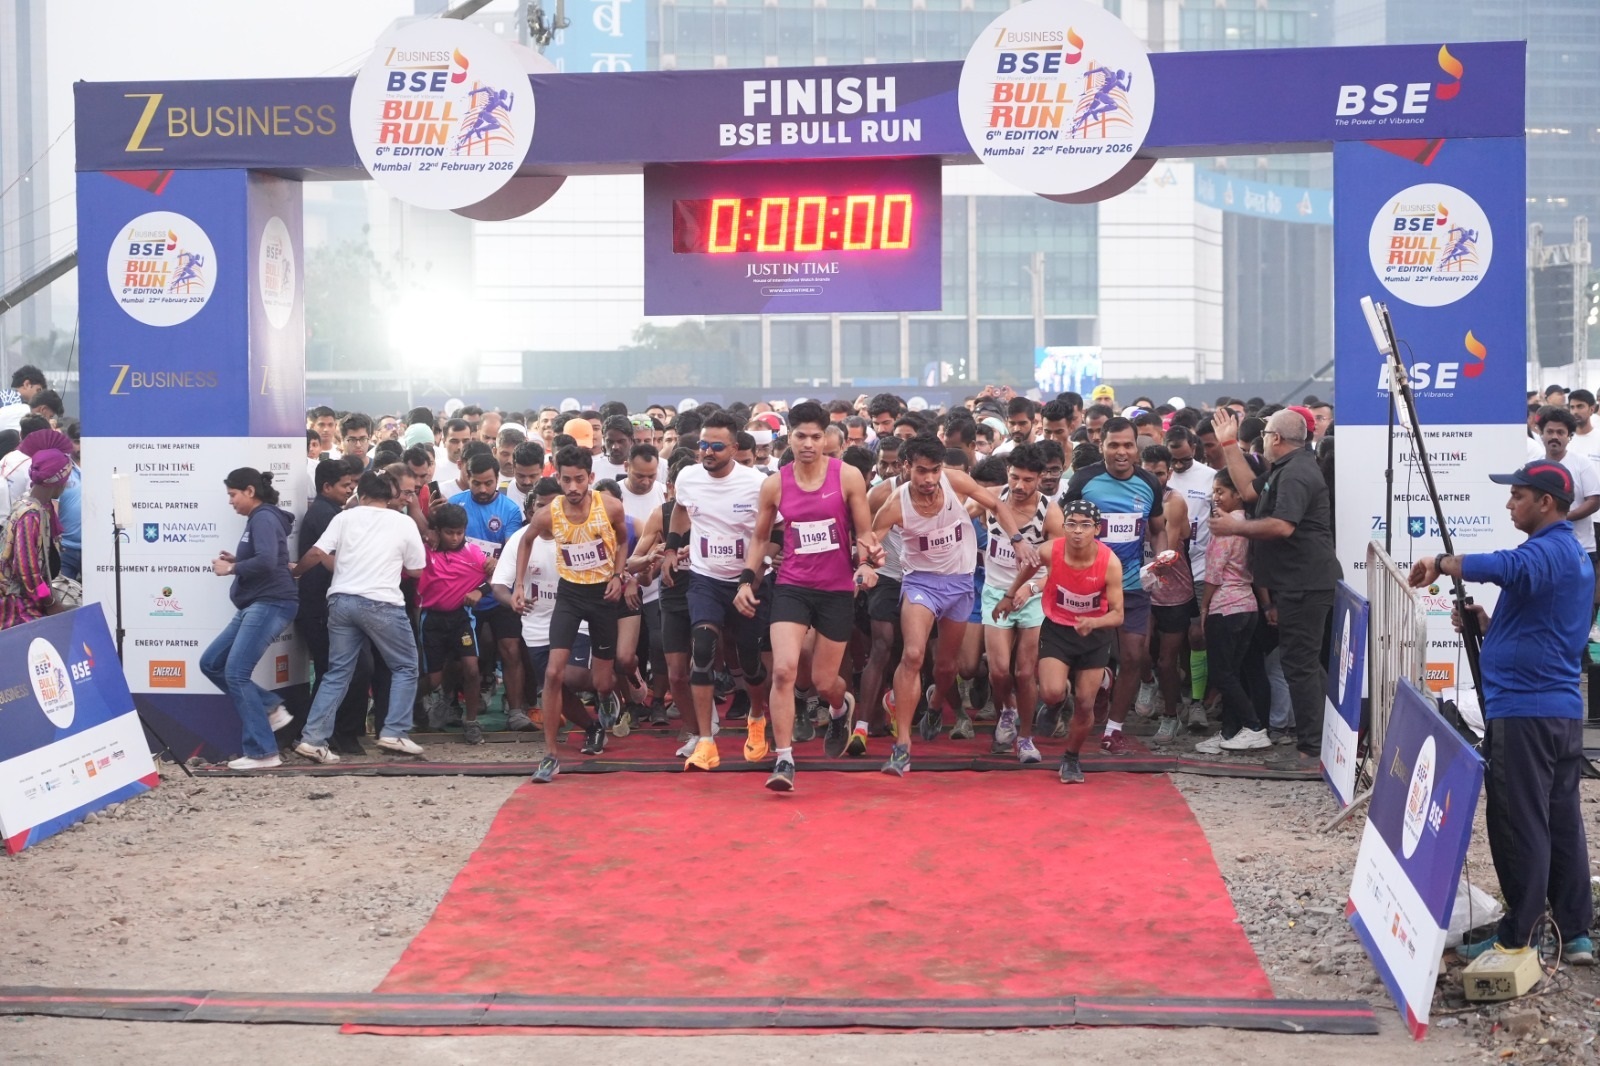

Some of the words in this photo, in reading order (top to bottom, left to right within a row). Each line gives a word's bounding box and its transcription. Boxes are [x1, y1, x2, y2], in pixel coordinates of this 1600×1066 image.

[1008, 31, 1064, 42] BUSINESS
[398, 50, 450, 62] BUSINESS
[997, 52, 1062, 74] BSE
[387, 72, 448, 92] BSE
[743, 76, 896, 116] FINISH
[993, 82, 1074, 103] BULL
[1336, 82, 1431, 116] BSE
[382, 100, 458, 122] BULL
[989, 106, 1064, 128] RUN
[168, 105, 337, 138] BUSINESS
[1390, 116, 1425, 124] Vibrance
[380, 122, 450, 144] RUN
[719, 123, 771, 146] BSE
[781, 120, 852, 145] BULL
[861, 118, 921, 143] RUN
[986, 130, 1002, 140] 6th
[1004, 130, 1058, 140] EDITION
[376, 146, 390, 156] 6th
[393, 146, 444, 156] EDITION
[983, 146, 1024, 156] Mumbai
[1032, 144, 1054, 155] 22nd
[1056, 144, 1102, 156] February
[1106, 144, 1132, 153] 2026
[373, 162, 411, 172] Mumbai
[418, 162, 438, 171] 22nd
[440, 161, 486, 172] February
[488, 160, 514, 172] 2026
[1400, 204, 1436, 213] BUSINESS
[708, 194, 912, 254] 0:00:00
[1393, 218, 1434, 231] BSE
[1390, 236, 1442, 250] BULL
[129, 244, 165, 256] BSE
[1388, 250, 1434, 265] RUN
[126, 260, 171, 274] BULL
[745, 264, 780, 278] JUST
[783, 263, 799, 274] IN
[802, 262, 840, 274] TIME
[125, 274, 166, 287] RUN
[1430, 274, 1460, 283] February
[1460, 274, 1478, 282] 2026
[131, 371, 218, 388] BUSINESS
[1440, 452, 1467, 461] TIME
[134, 463, 156, 472] JUST
[158, 463, 169, 471] IN
[170, 462, 195, 471] TIME
[163, 523, 216, 531] NANAVATI
[1109, 524, 1133, 532] 10323
[1430, 528, 1456, 537] MX
[163, 534, 187, 542] MAX
[802, 532, 827, 542] 11492
[930, 534, 953, 546] 10811
[710, 545, 733, 554] 11395
[999, 547, 1016, 559] 1114
[572, 551, 595, 562] 11149
[540, 590, 557, 599] 1101
[1066, 598, 1090, 607] 10839
[35, 663, 49, 676] BSE
[71, 660, 91, 680] BSE
[152, 666, 182, 677] ENERZAL
[1426, 670, 1449, 680] ERZAL
[1429, 800, 1443, 832] BSE
